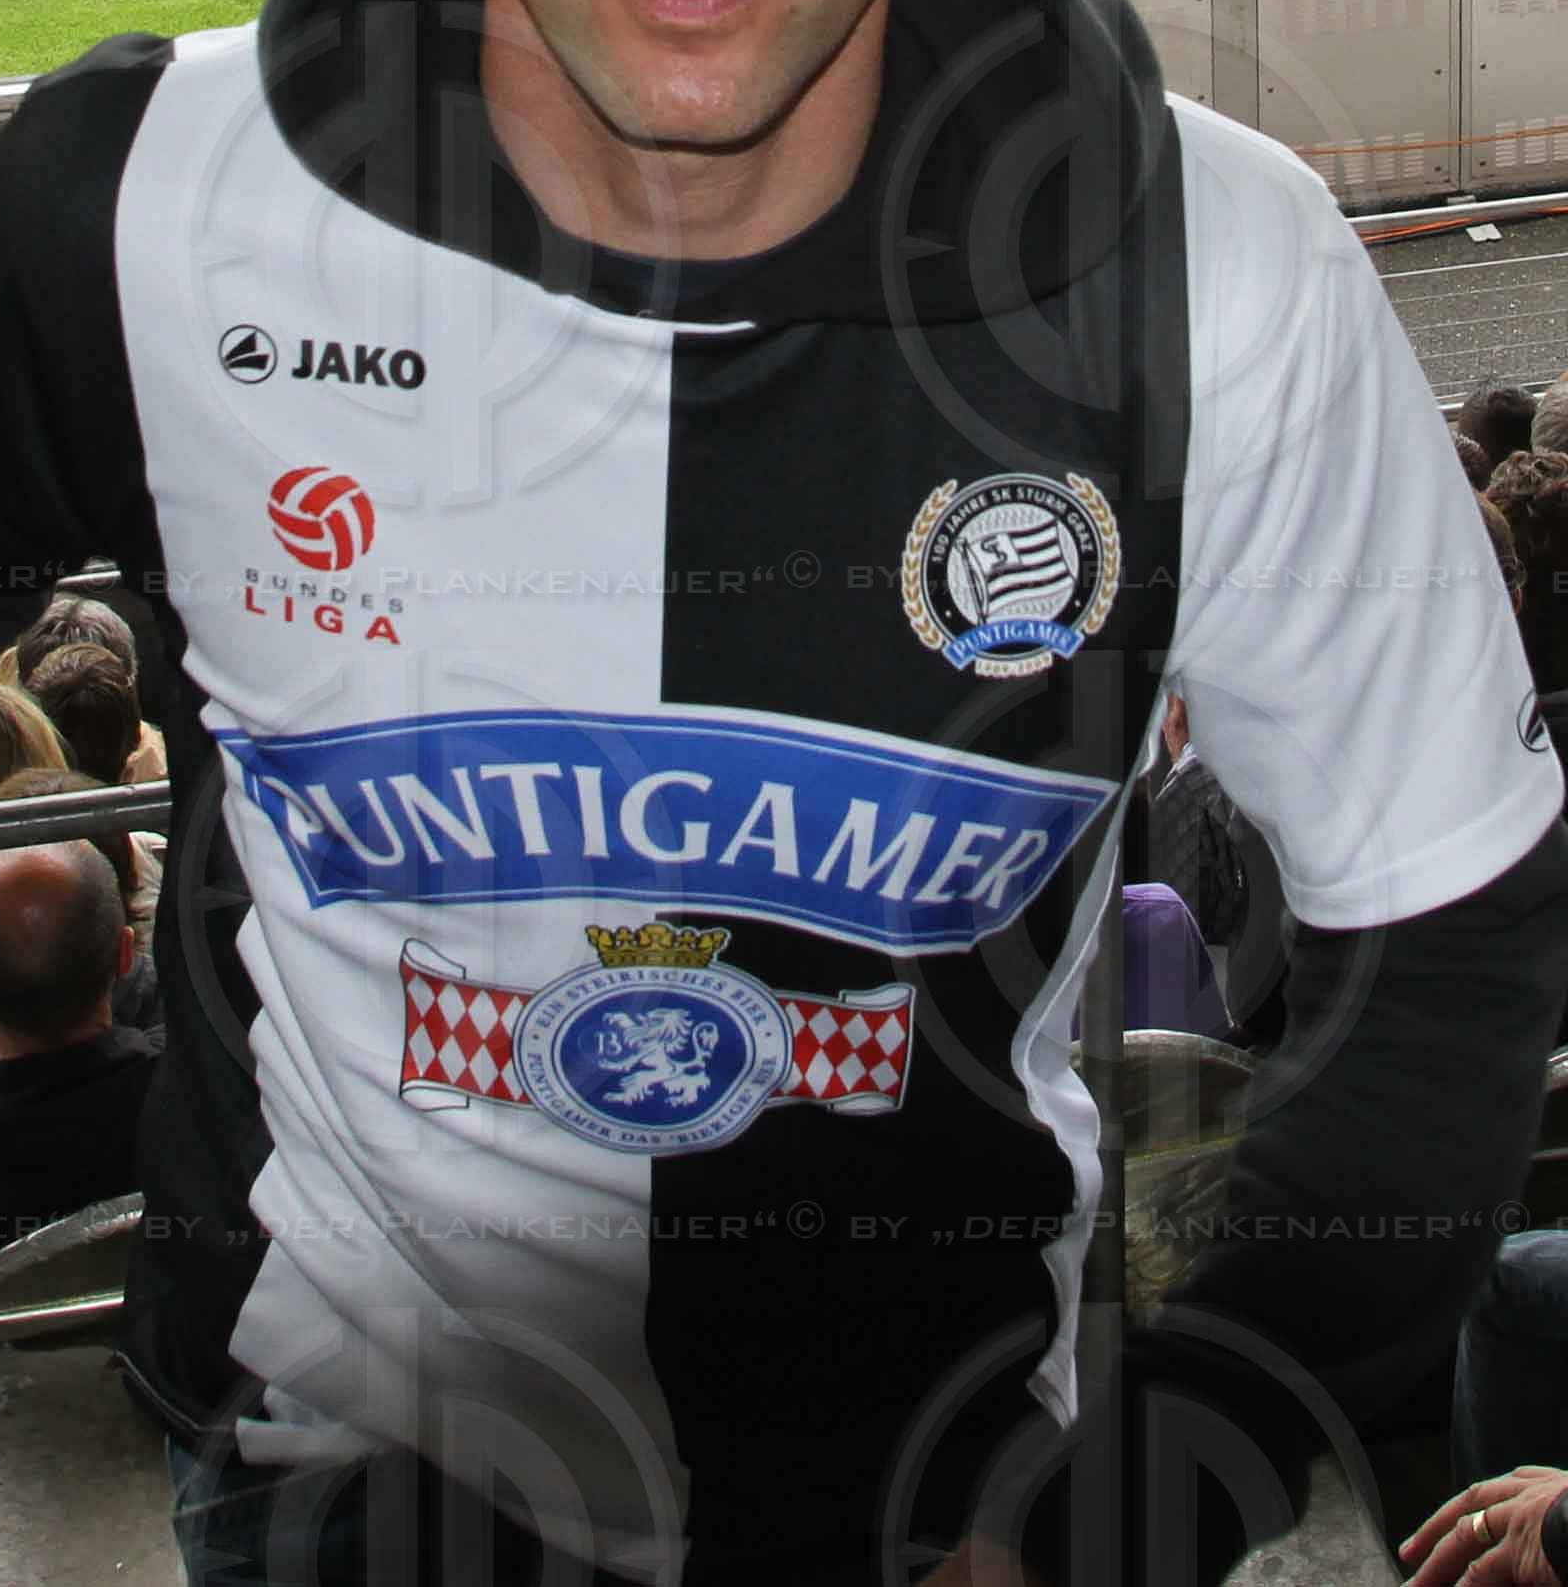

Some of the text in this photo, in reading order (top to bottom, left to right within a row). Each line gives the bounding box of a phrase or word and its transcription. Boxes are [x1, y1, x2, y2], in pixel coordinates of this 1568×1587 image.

[291, 339, 426, 390] JAKO
[932, 486, 1095, 562] 100 JAHRE SK STURM GRAZ
[245, 567, 404, 614] BUNDES
[245, 585, 401, 645] LIGA
[952, 624, 1075, 660] PUNTIGAMER
[258, 762, 1049, 910] PUNTIGAMER
[535, 1001, 563, 1029] EIN
[565, 969, 726, 1001] STEIRISCHES
[620, 1131, 661, 1144] DAS
